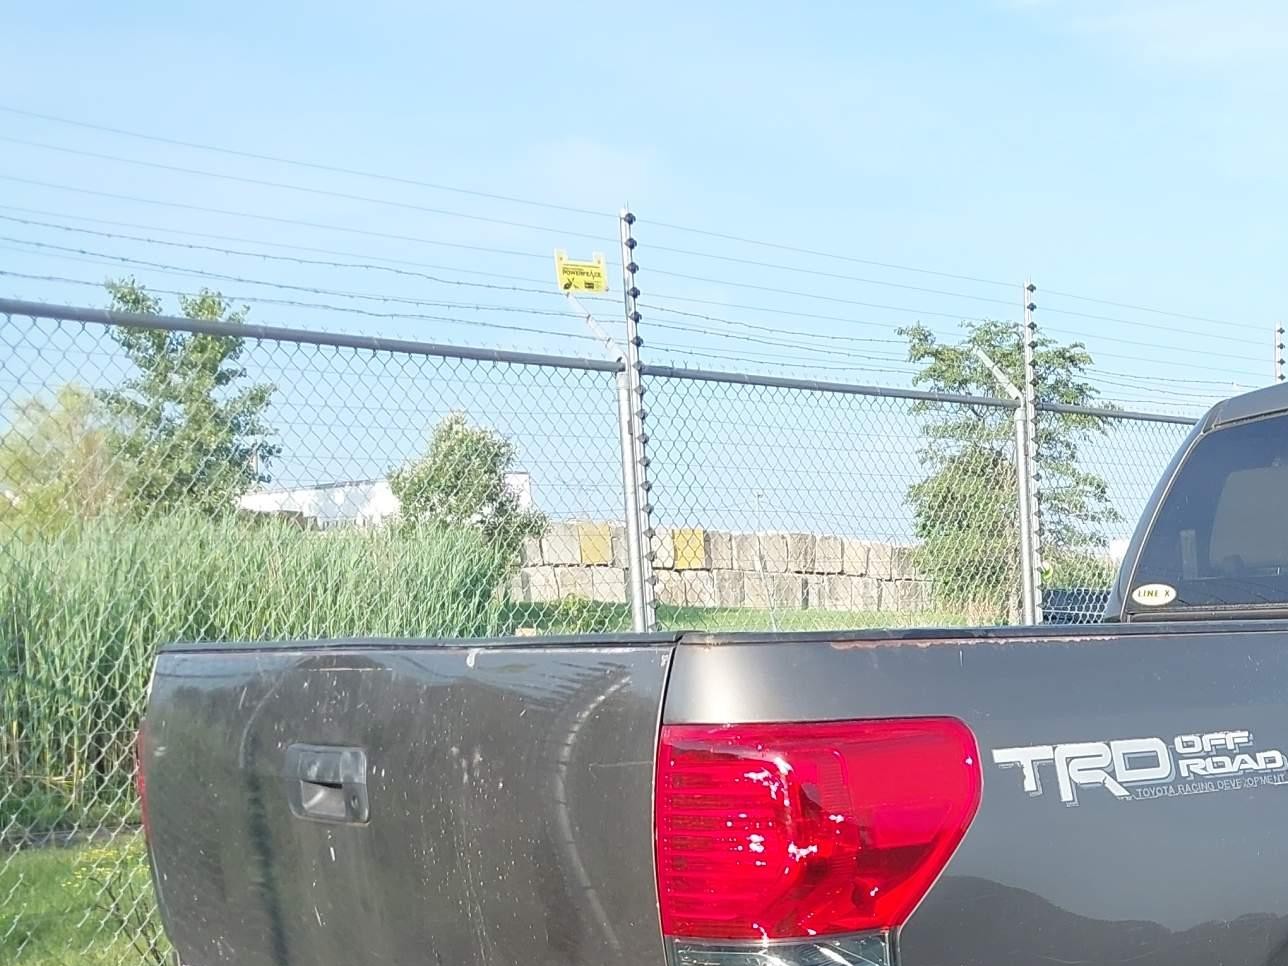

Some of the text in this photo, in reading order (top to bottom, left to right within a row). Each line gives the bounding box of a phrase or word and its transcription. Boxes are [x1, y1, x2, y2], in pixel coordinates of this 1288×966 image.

[1174, 730, 1252, 754] OFF
[992, 737, 1172, 804] TRD
[1178, 750, 1286, 779] ROAD
[1136, 786, 1175, 798] TOYOTA
[1177, 781, 1216, 794] RACING
